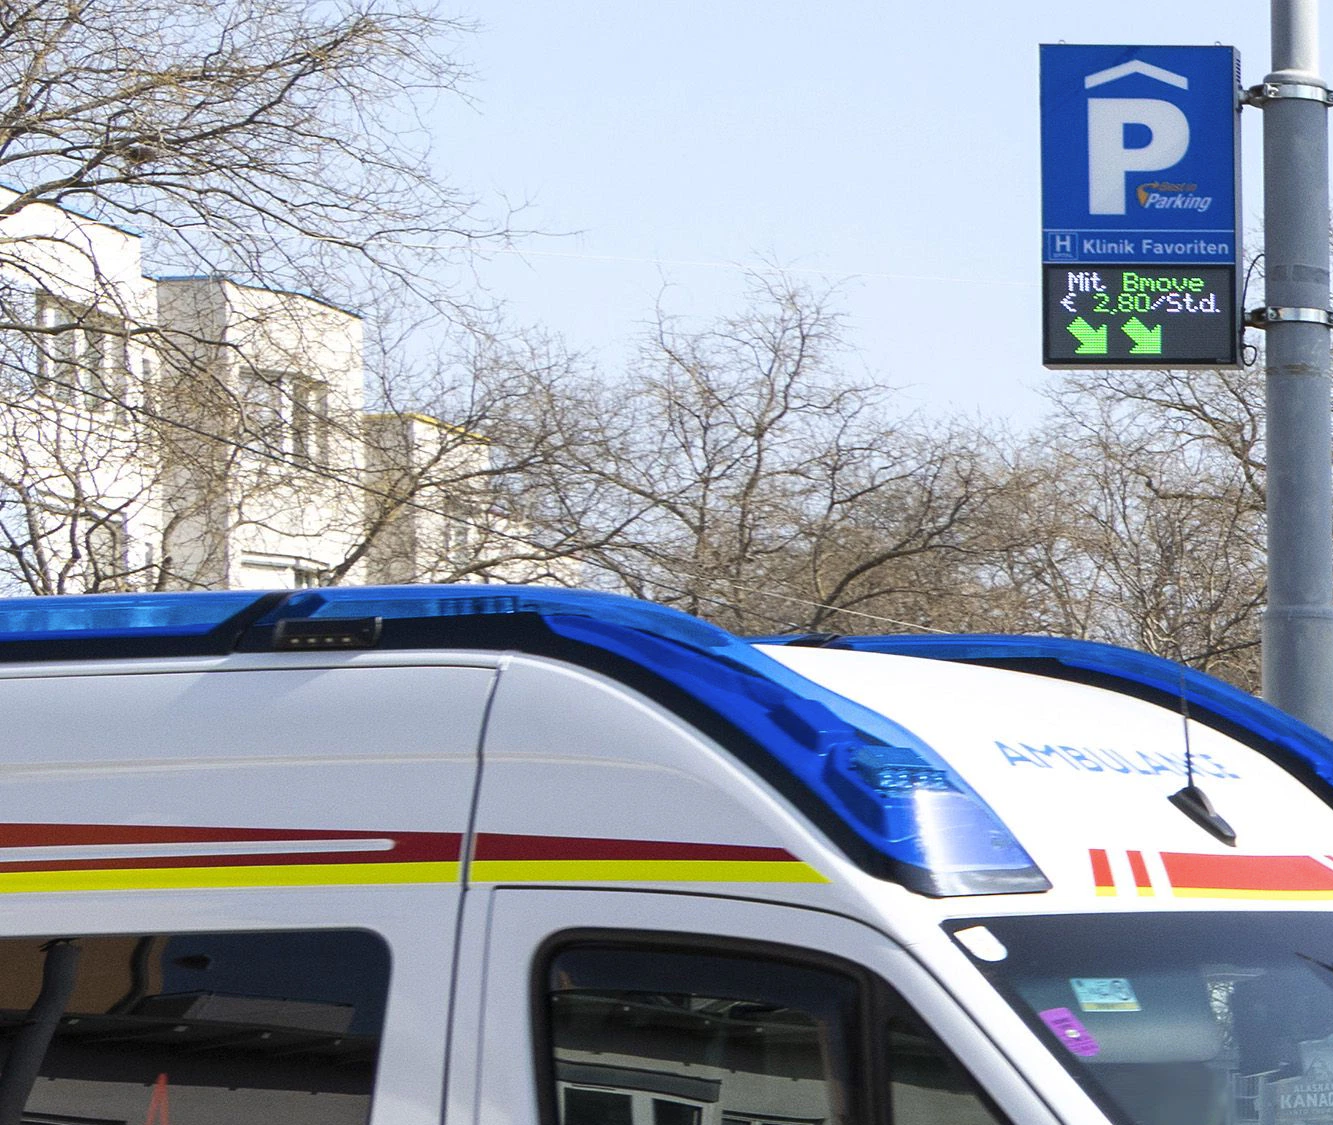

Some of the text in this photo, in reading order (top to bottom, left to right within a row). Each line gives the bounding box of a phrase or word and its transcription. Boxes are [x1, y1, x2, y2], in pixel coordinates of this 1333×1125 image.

[1087, 98, 1190, 215] P
[1144, 193, 1212, 212] Parking
[1055, 235, 1229, 255] H Klinik Favoriten
[1068, 272, 1204, 292] Mit Bmove
[1093, 293, 1221, 315] 2,80/Std.
